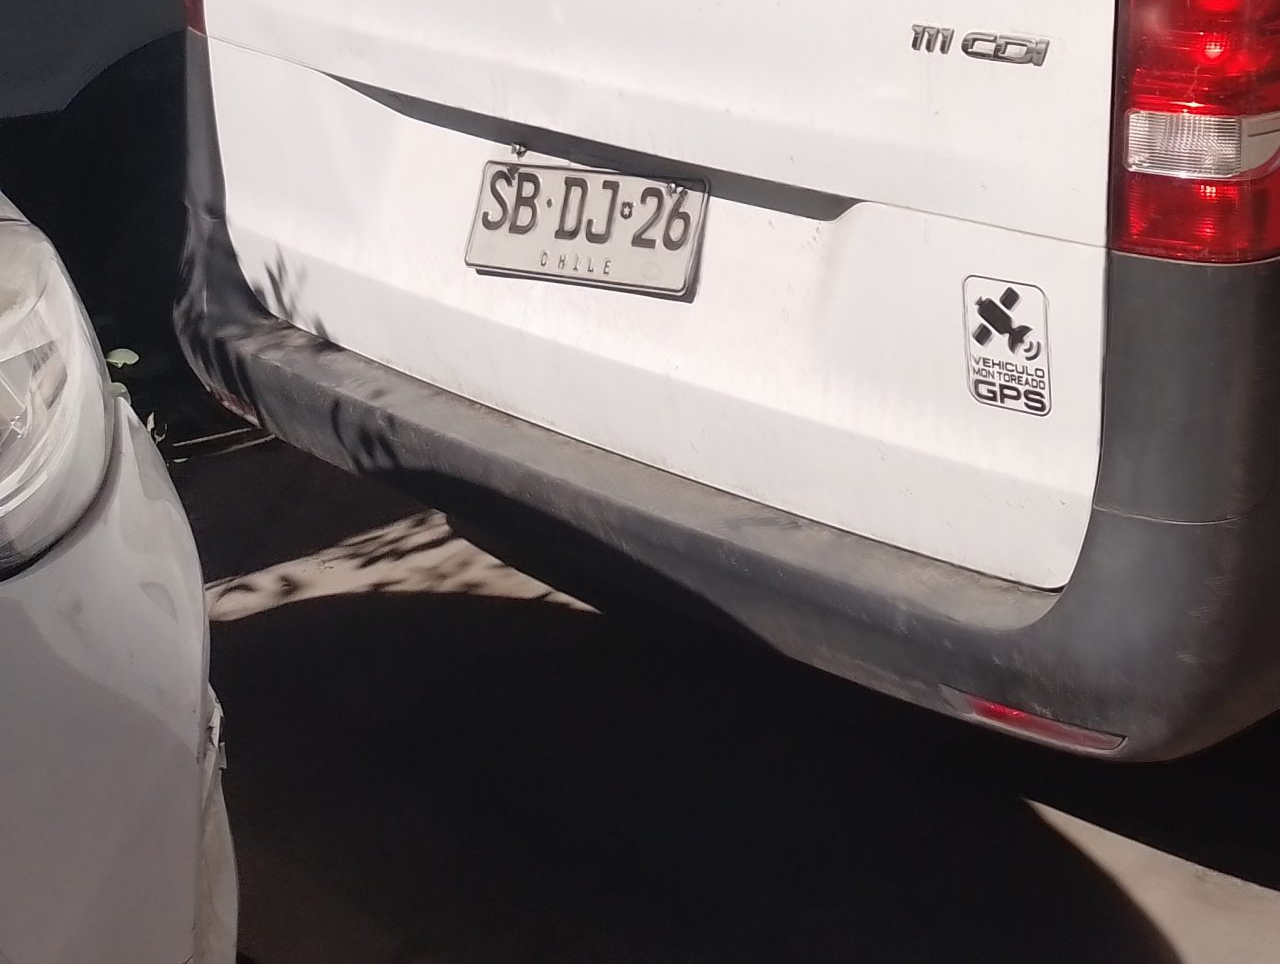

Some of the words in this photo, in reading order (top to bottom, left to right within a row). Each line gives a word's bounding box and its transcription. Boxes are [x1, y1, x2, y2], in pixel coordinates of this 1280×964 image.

[961, 32, 1051, 67] CDI
[539, 249, 613, 276] CHILE
[971, 354, 1046, 378] VEHICULO
[973, 378, 1047, 413] GPS
